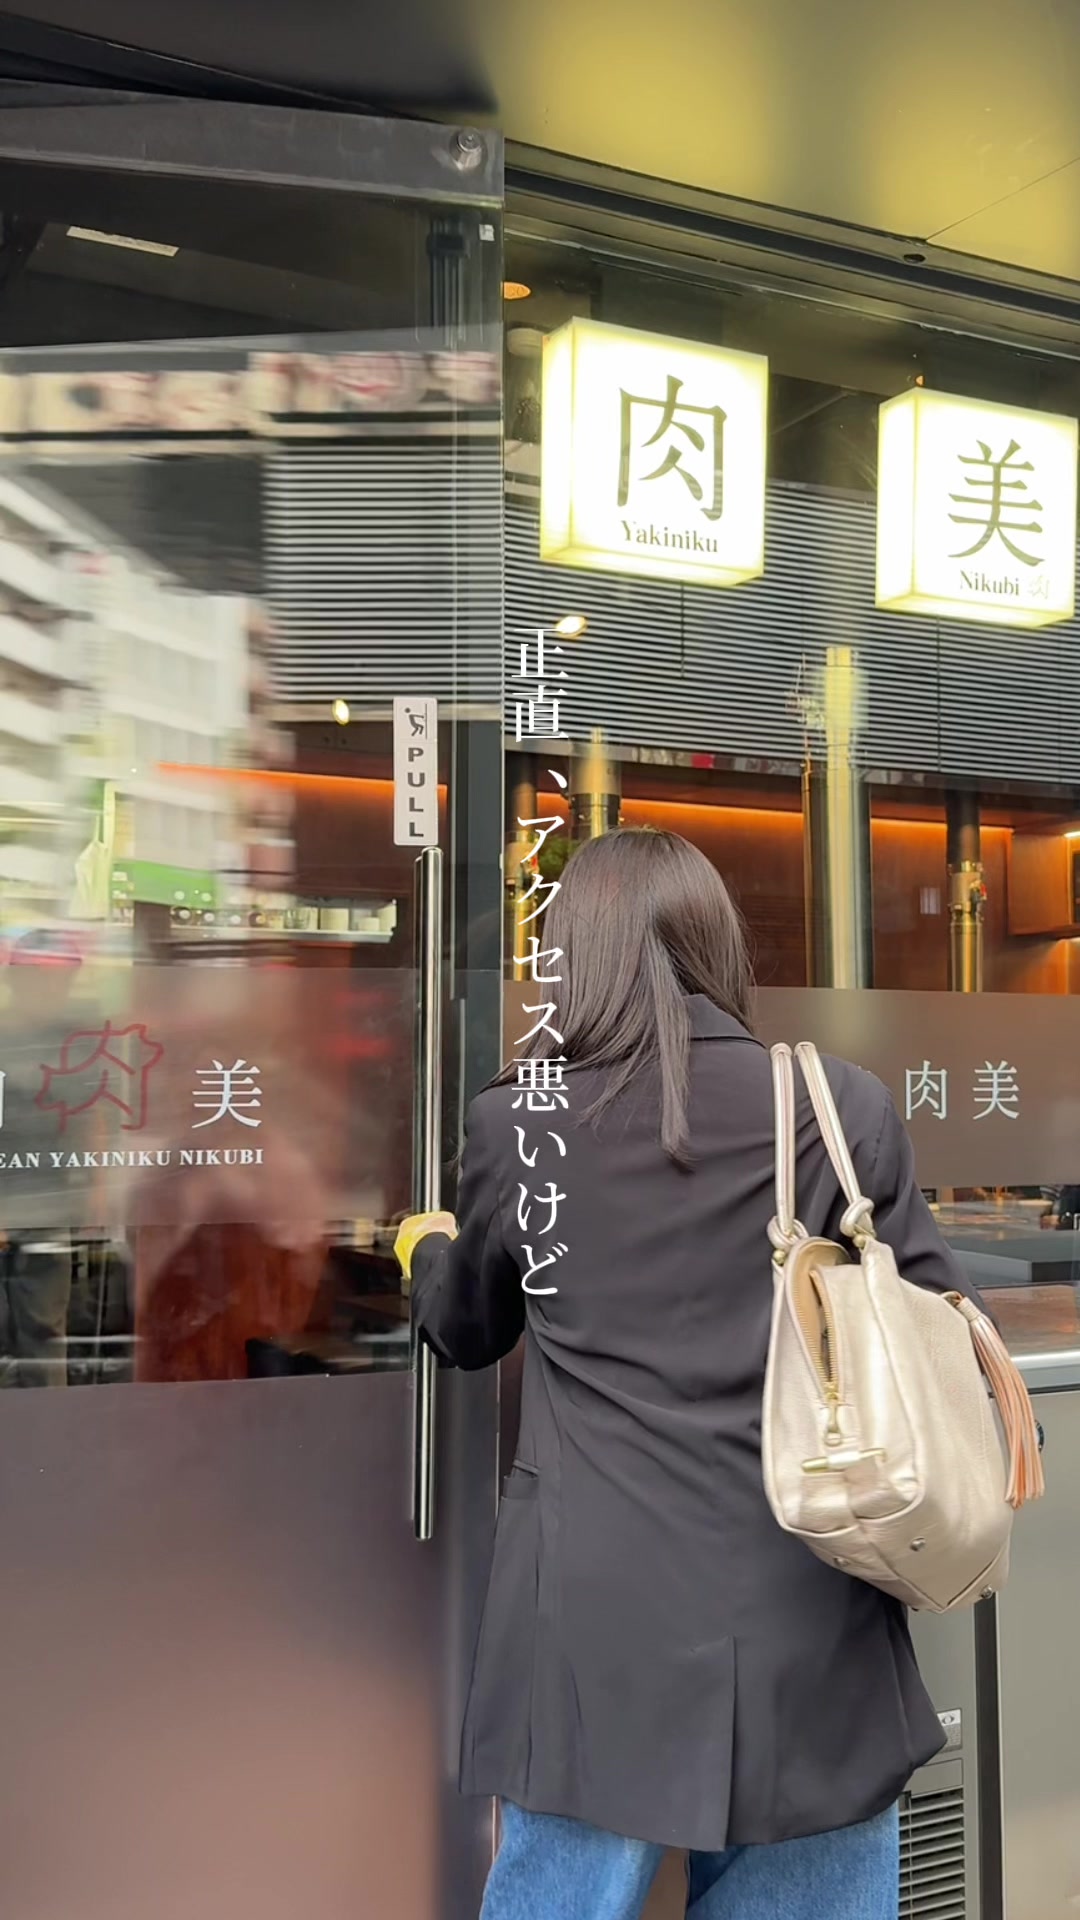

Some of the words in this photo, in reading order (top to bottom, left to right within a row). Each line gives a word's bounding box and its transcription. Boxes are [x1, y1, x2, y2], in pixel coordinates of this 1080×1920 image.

[617, 374, 728, 521] 肉
[621, 519, 719, 553] Yakiniku
[947, 438, 1045, 567] 美
[959, 569, 1020, 596] Nikubi
[407, 747, 425, 837] PULL
[191, 1059, 262, 1128] 美
[49, 1151, 171, 1168] YAKINIKU
[179, 1149, 264, 1165] NIKUBI
